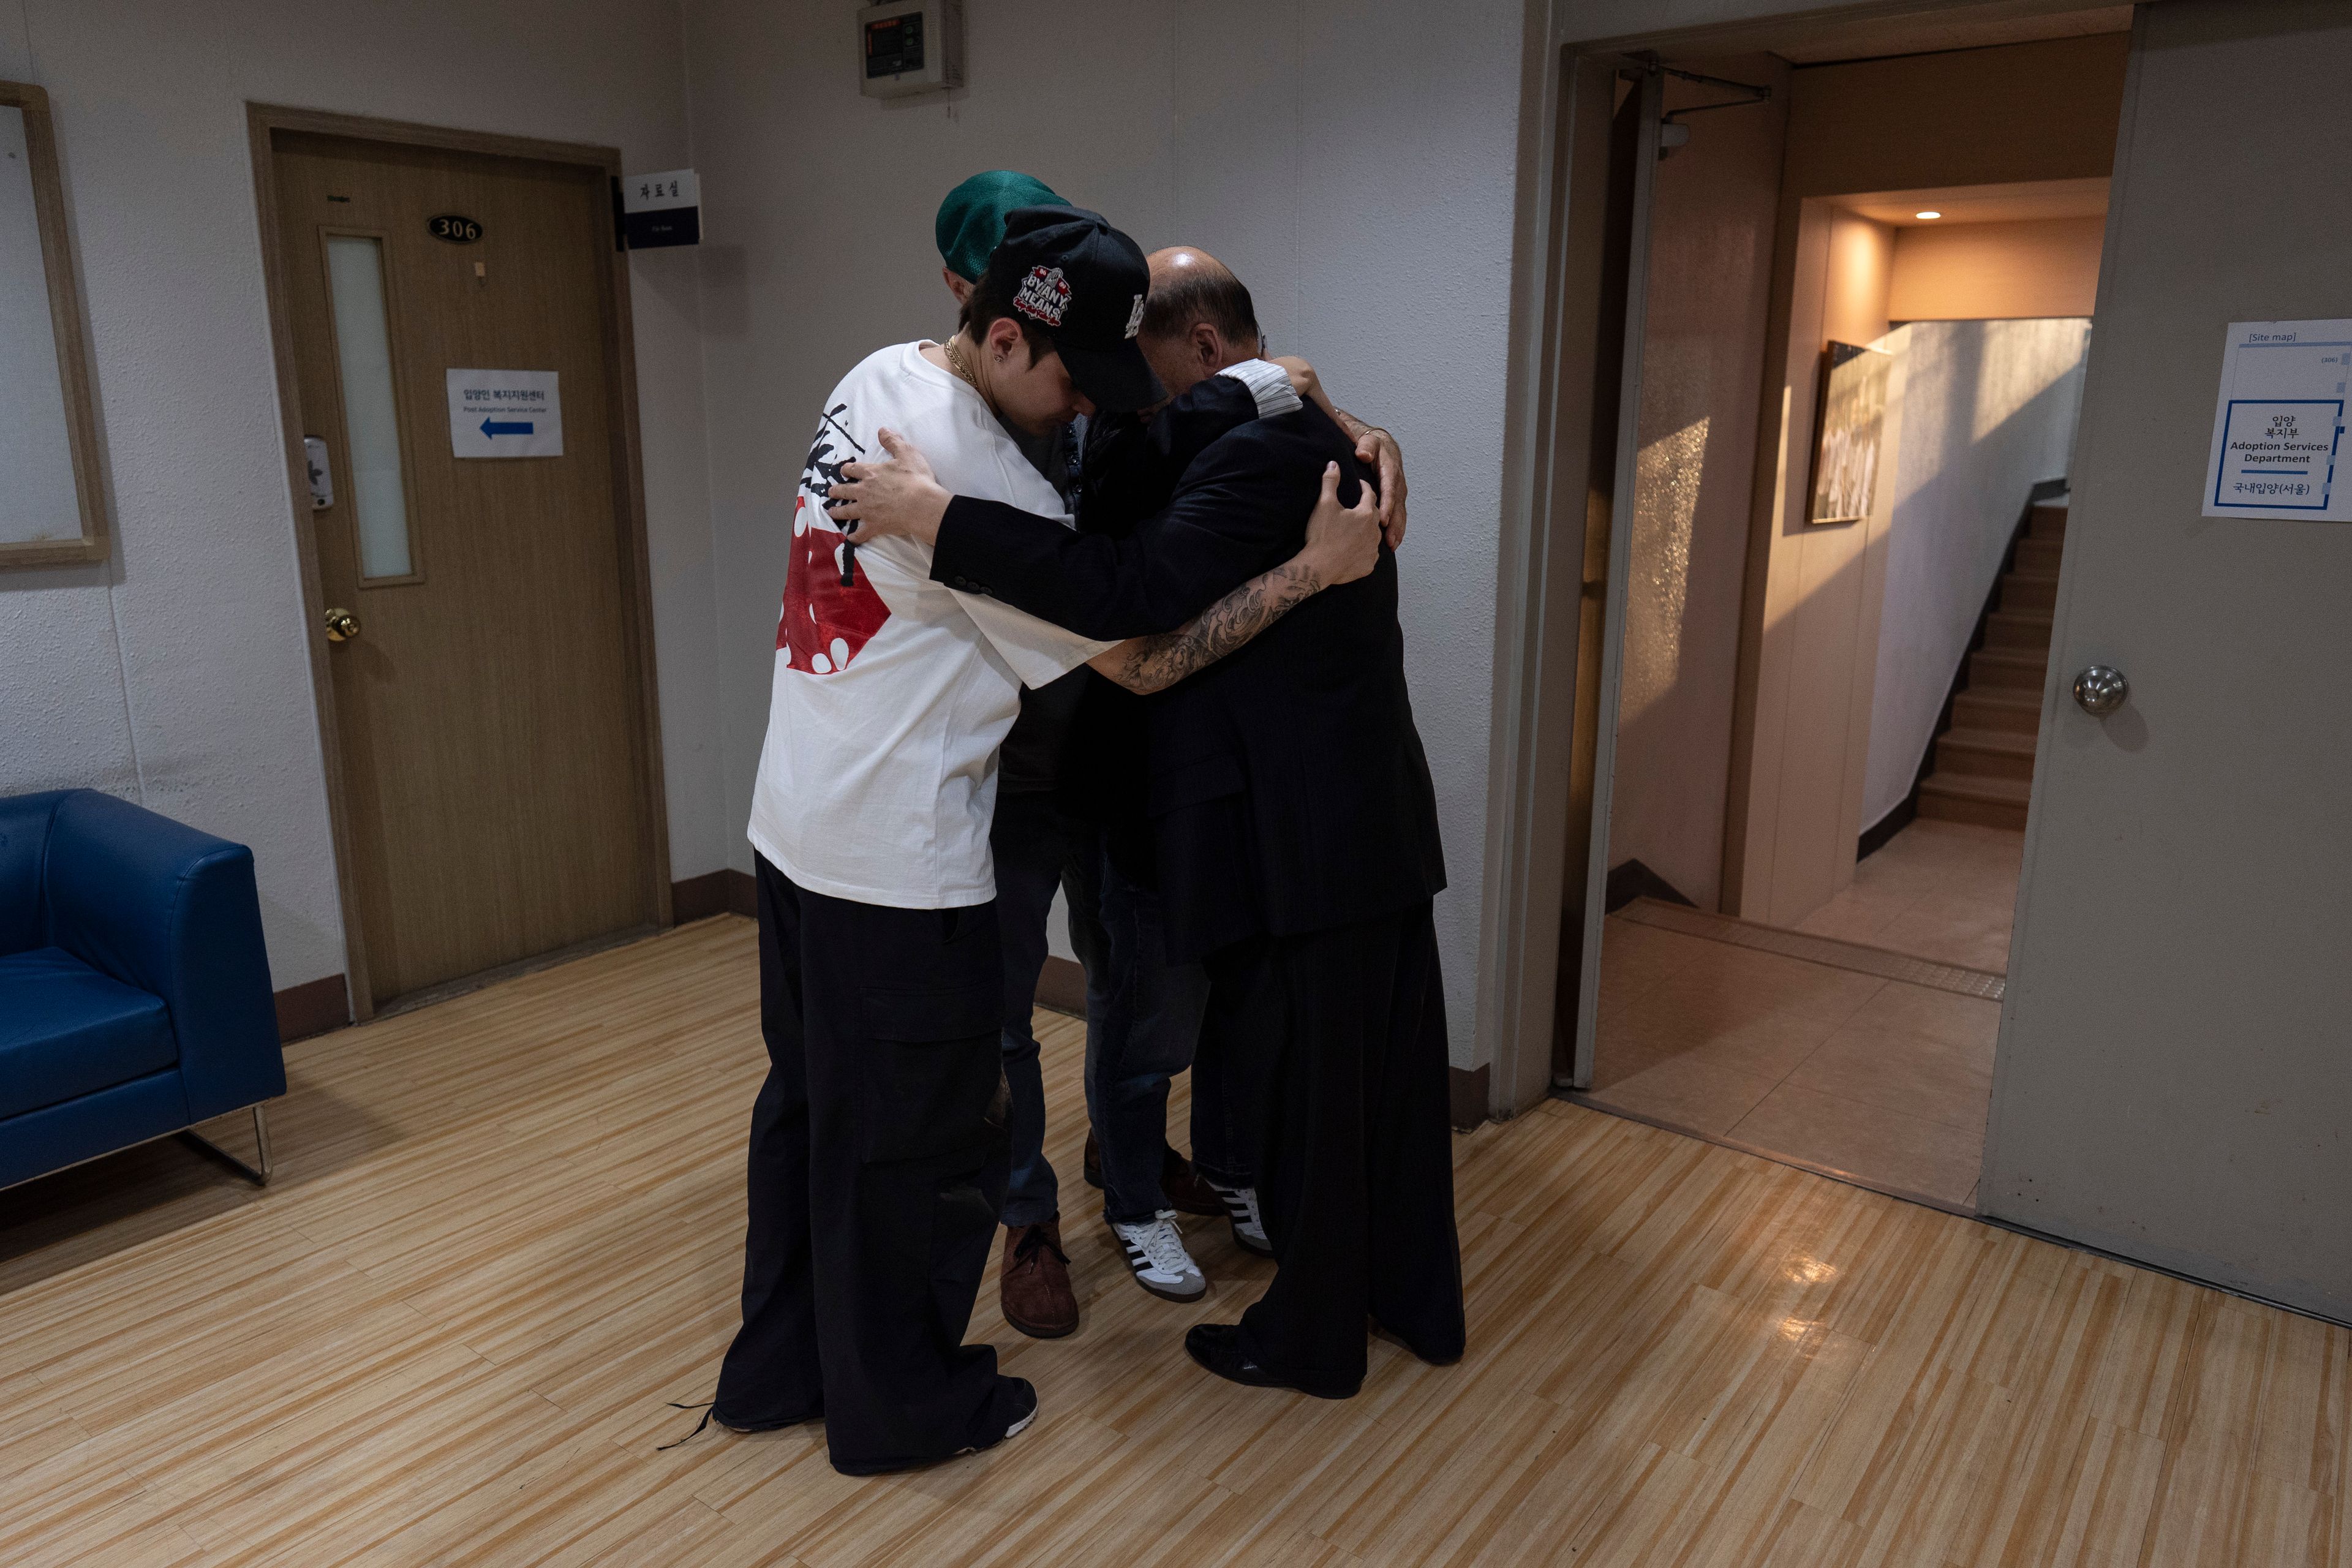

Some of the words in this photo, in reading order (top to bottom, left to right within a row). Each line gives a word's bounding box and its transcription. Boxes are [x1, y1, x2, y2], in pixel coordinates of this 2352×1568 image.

[439, 219, 476, 239] 306
[1027, 274, 1044, 292] BY
[1041, 285, 1068, 307] ANY
[1020, 286, 1061, 318] MEANS
[2248, 333, 2269, 343] [Site
[2272, 332, 2296, 342] map]
[464, 389, 490, 401] 입양인
[494, 390, 545, 401] 복지지원센터
[2272, 415, 2296, 428] 입양
[2264, 428, 2299, 439] 복지부
[2230, 442, 2280, 452] Adoption
[2283, 442, 2329, 451] Services
[2244, 454, 2311, 464] Department
[2233, 482, 2310, 495] 국내입양(서울)
